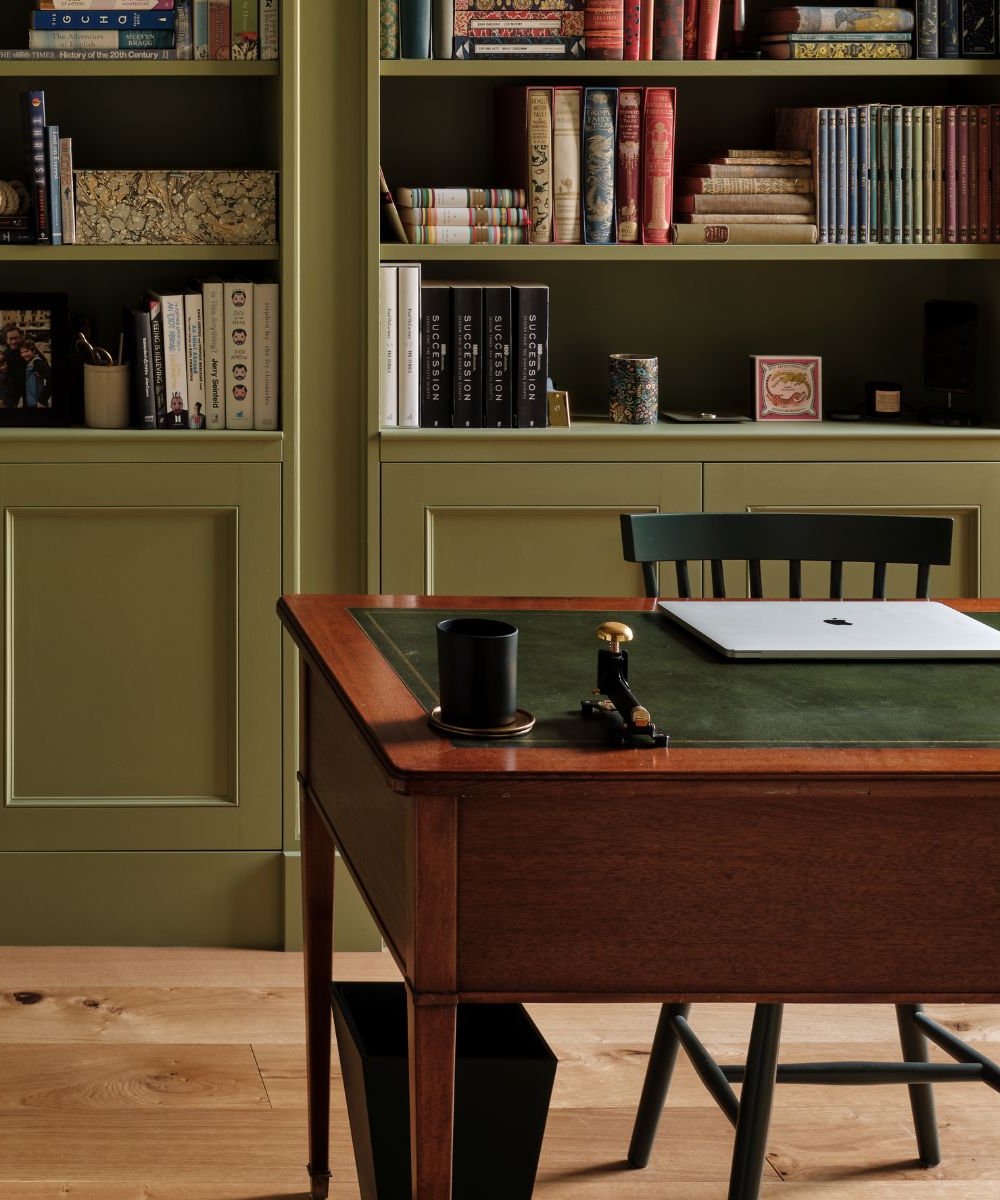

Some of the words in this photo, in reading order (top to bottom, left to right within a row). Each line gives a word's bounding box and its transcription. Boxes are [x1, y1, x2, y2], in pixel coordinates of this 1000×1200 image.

[60, 51, 86, 59] History
[87, 51, 95, 59] of
[96, 51, 108, 59] the
[110, 51, 127, 59] 20th
[129, 51, 158, 59] Century
[33, 115, 44, 185] THRUST
[53, 146, 58, 154] on
[263, 303, 271, 329] stephen
[263, 331, 271, 341] fry
